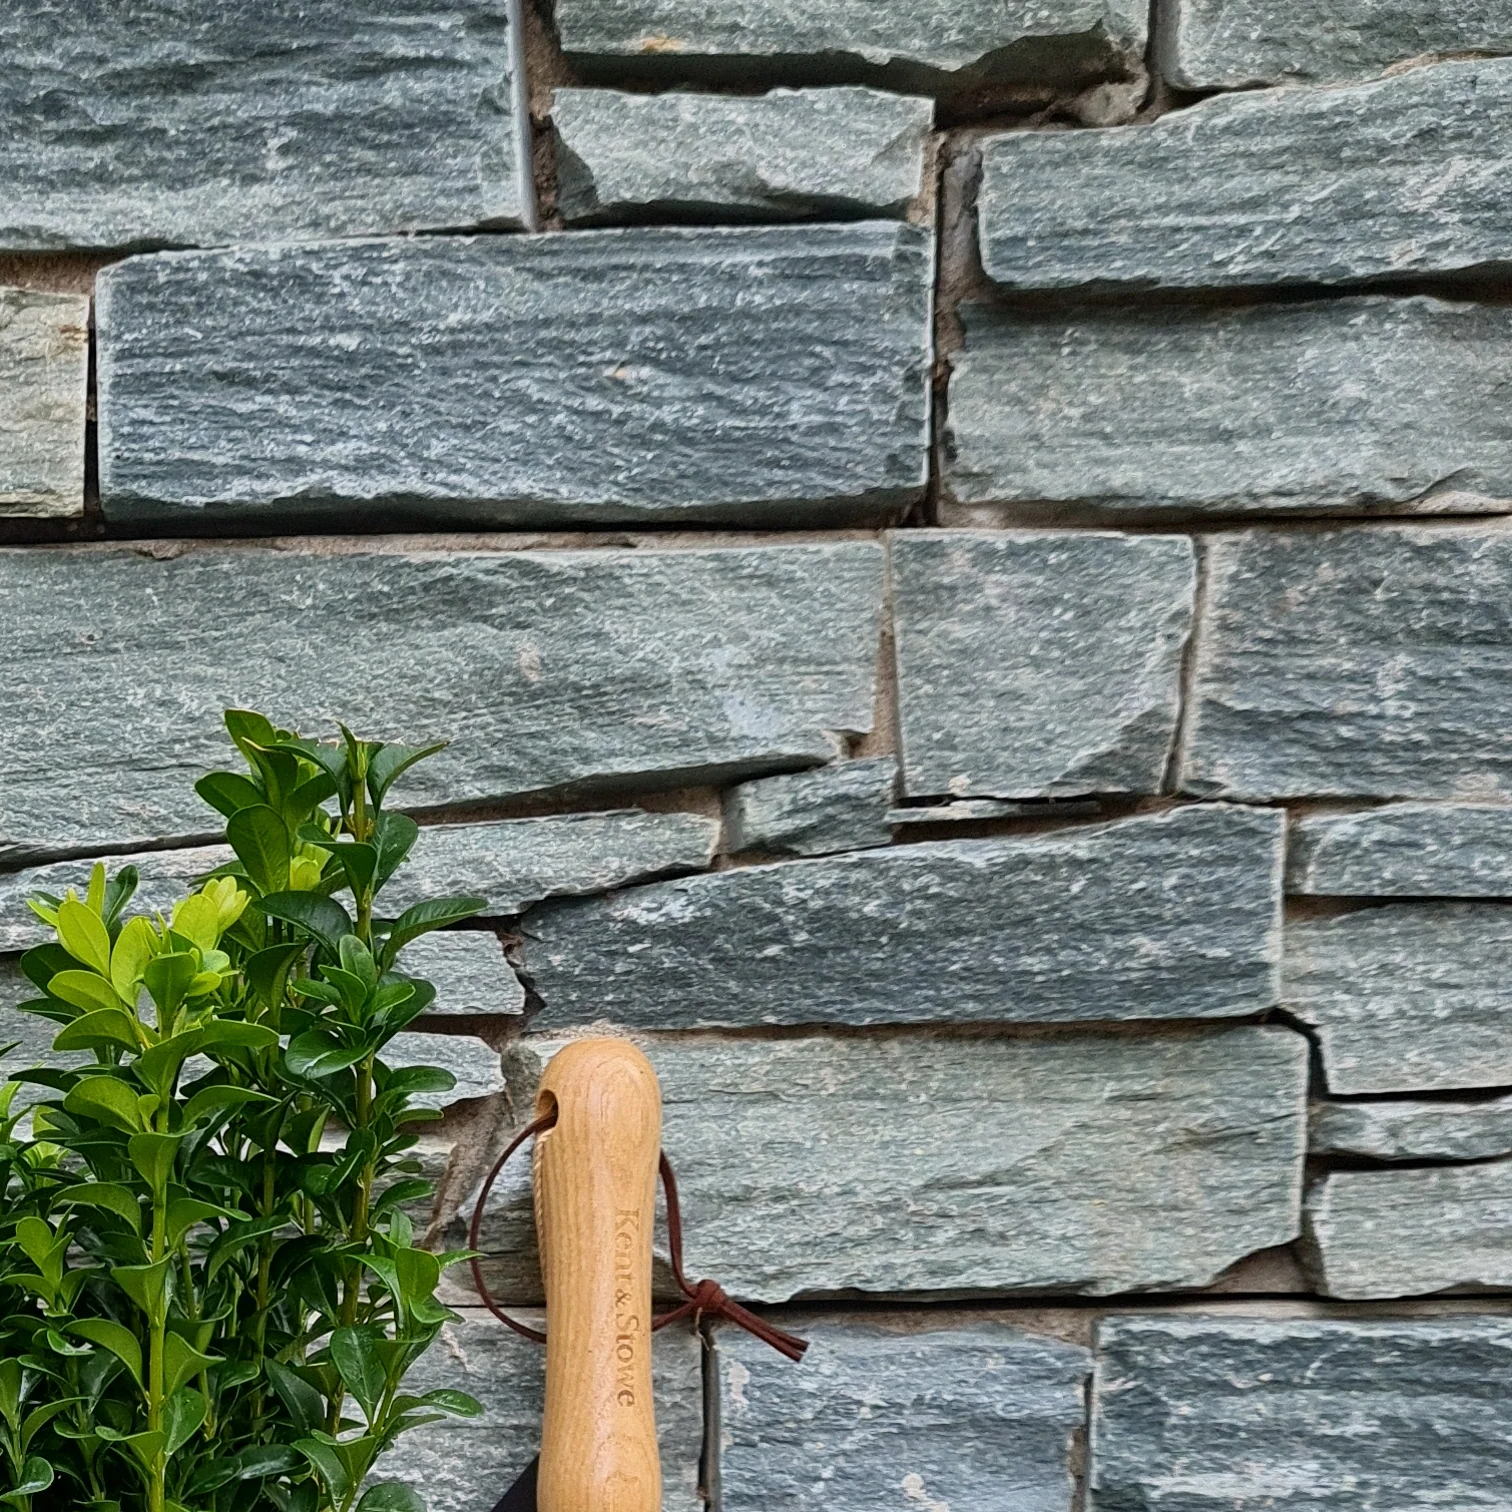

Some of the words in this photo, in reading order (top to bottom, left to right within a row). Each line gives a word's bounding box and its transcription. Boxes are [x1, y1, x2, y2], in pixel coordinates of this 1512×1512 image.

[615, 1208, 640, 1281] Kent
[615, 1288, 633, 1308] &
[615, 1314, 640, 1407] Stowe
